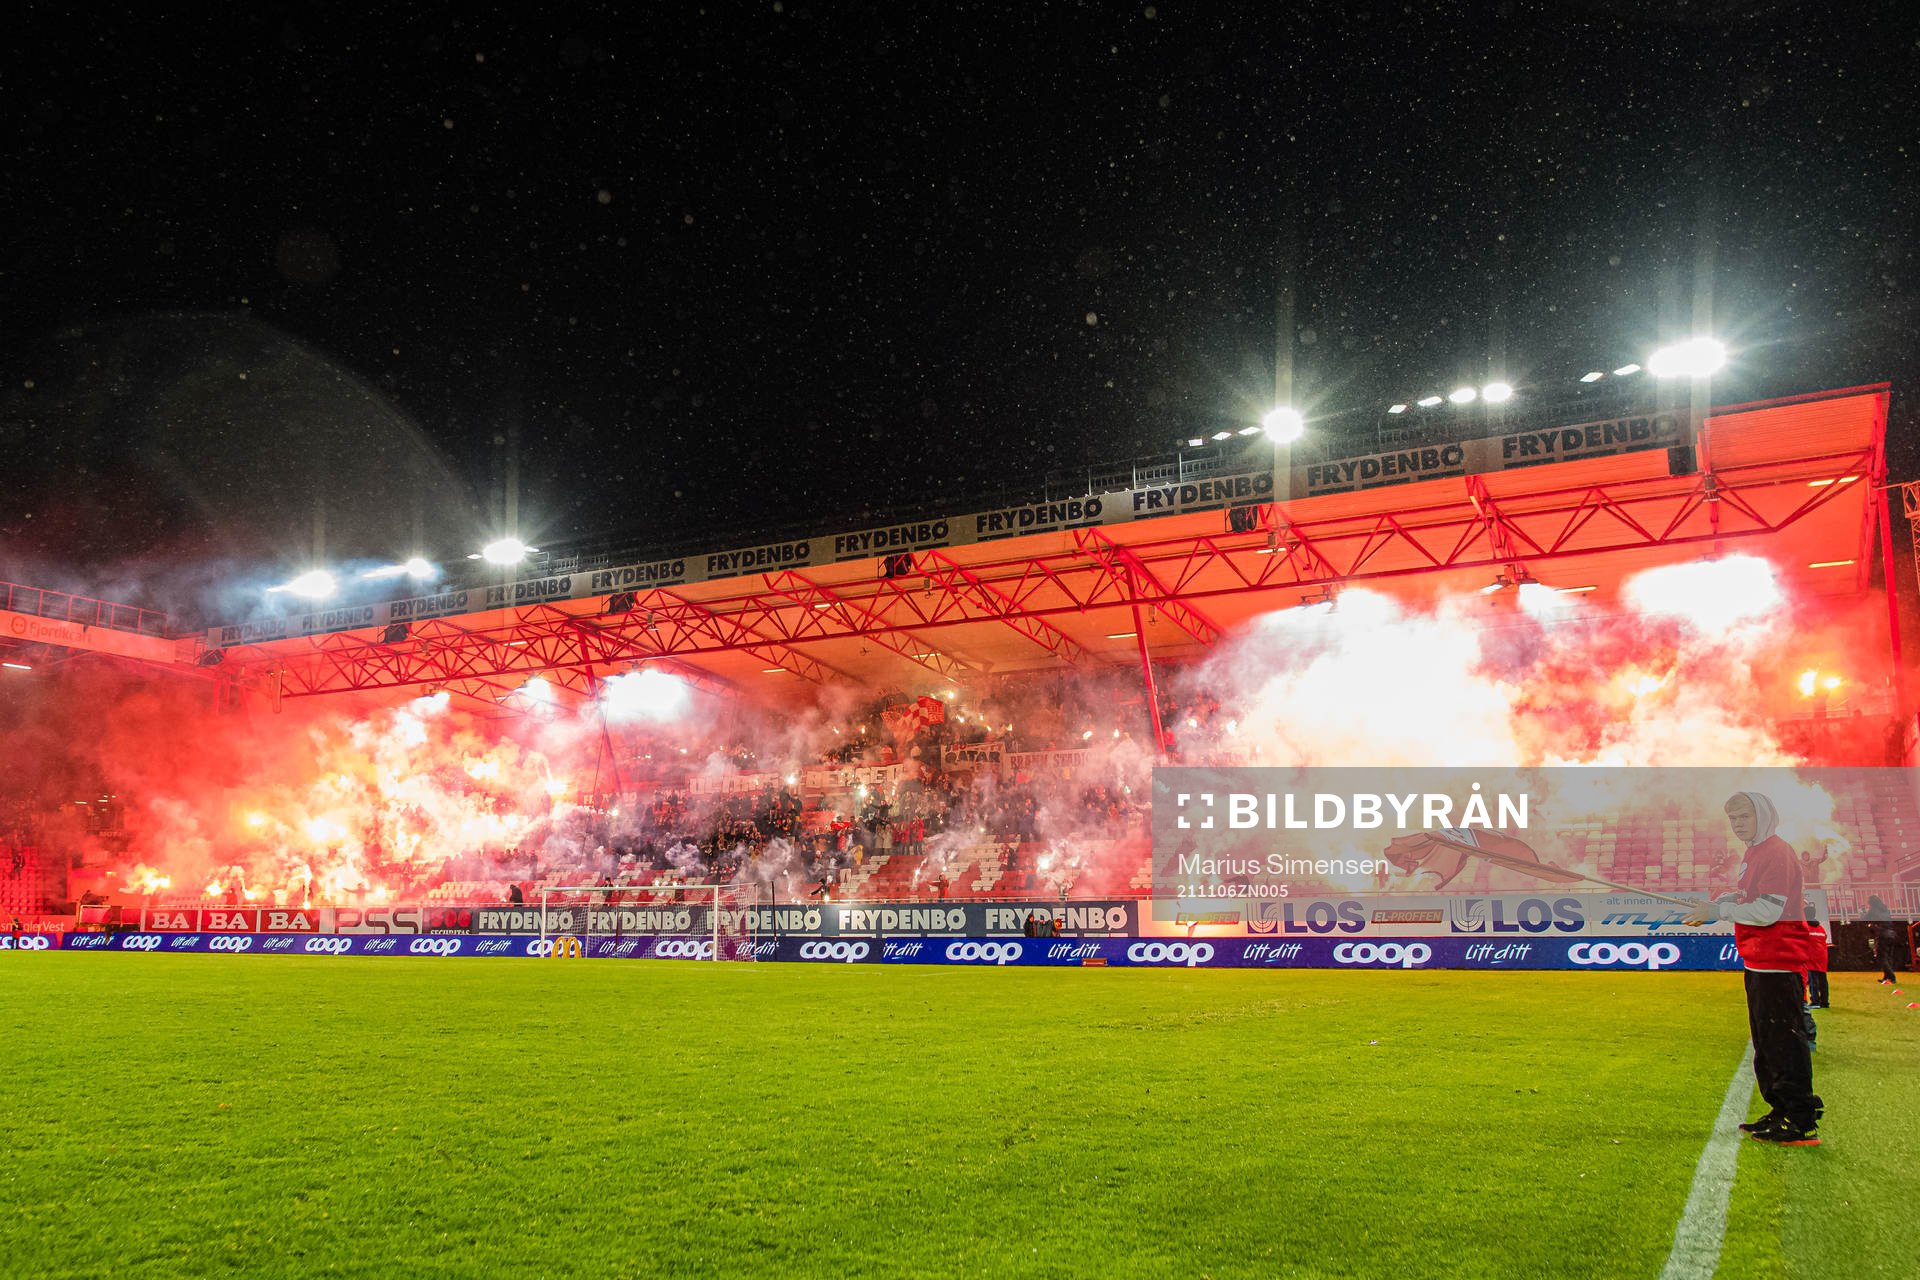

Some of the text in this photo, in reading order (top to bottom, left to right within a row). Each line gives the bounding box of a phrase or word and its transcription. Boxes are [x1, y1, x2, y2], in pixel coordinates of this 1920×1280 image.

[976, 496, 1103, 534] FRYDENBØ
[834, 519, 949, 553] FRYDENBØ
[707, 539, 811, 572] FRYDENBØ
[591, 559, 685, 589] FRYDENBØ
[1606, 897, 1621, 905] alt
[1624, 896, 1653, 905] innen
[151, 912, 190, 929] BA
[208, 912, 249, 930] BA
[268, 912, 311, 930] BA
[478, 909, 574, 931] FRYDENBØ
[587, 909, 691, 931] FRYDENBØ
[706, 908, 822, 932] FRYDENBØ
[838, 906, 967, 932] FRYDENBØ
[985, 905, 1128, 932] FRYDENBØ
[1284, 900, 1366, 934] LOS
[1374, 911, 1442, 922] EL-PROFFEN
[1492, 898, 1585, 933] LOS
[88, 936, 115, 947] dit
[122, 935, 162, 952] coop
[208, 936, 253, 953] coop
[305, 937, 353, 955] coop
[410, 938, 461, 957] coop
[800, 941, 870, 963] coop
[882, 942, 924, 958] itt ditt
[1070, 943, 1101, 959] ditt
[1268, 943, 1303, 960] ditt
[1493, 943, 1533, 961] ditt
[945, 942, 1023, 966] coop
[1127, 942, 1215, 967] coop
[1333, 942, 1433, 968] coop
[1567, 942, 1681, 969] coop
